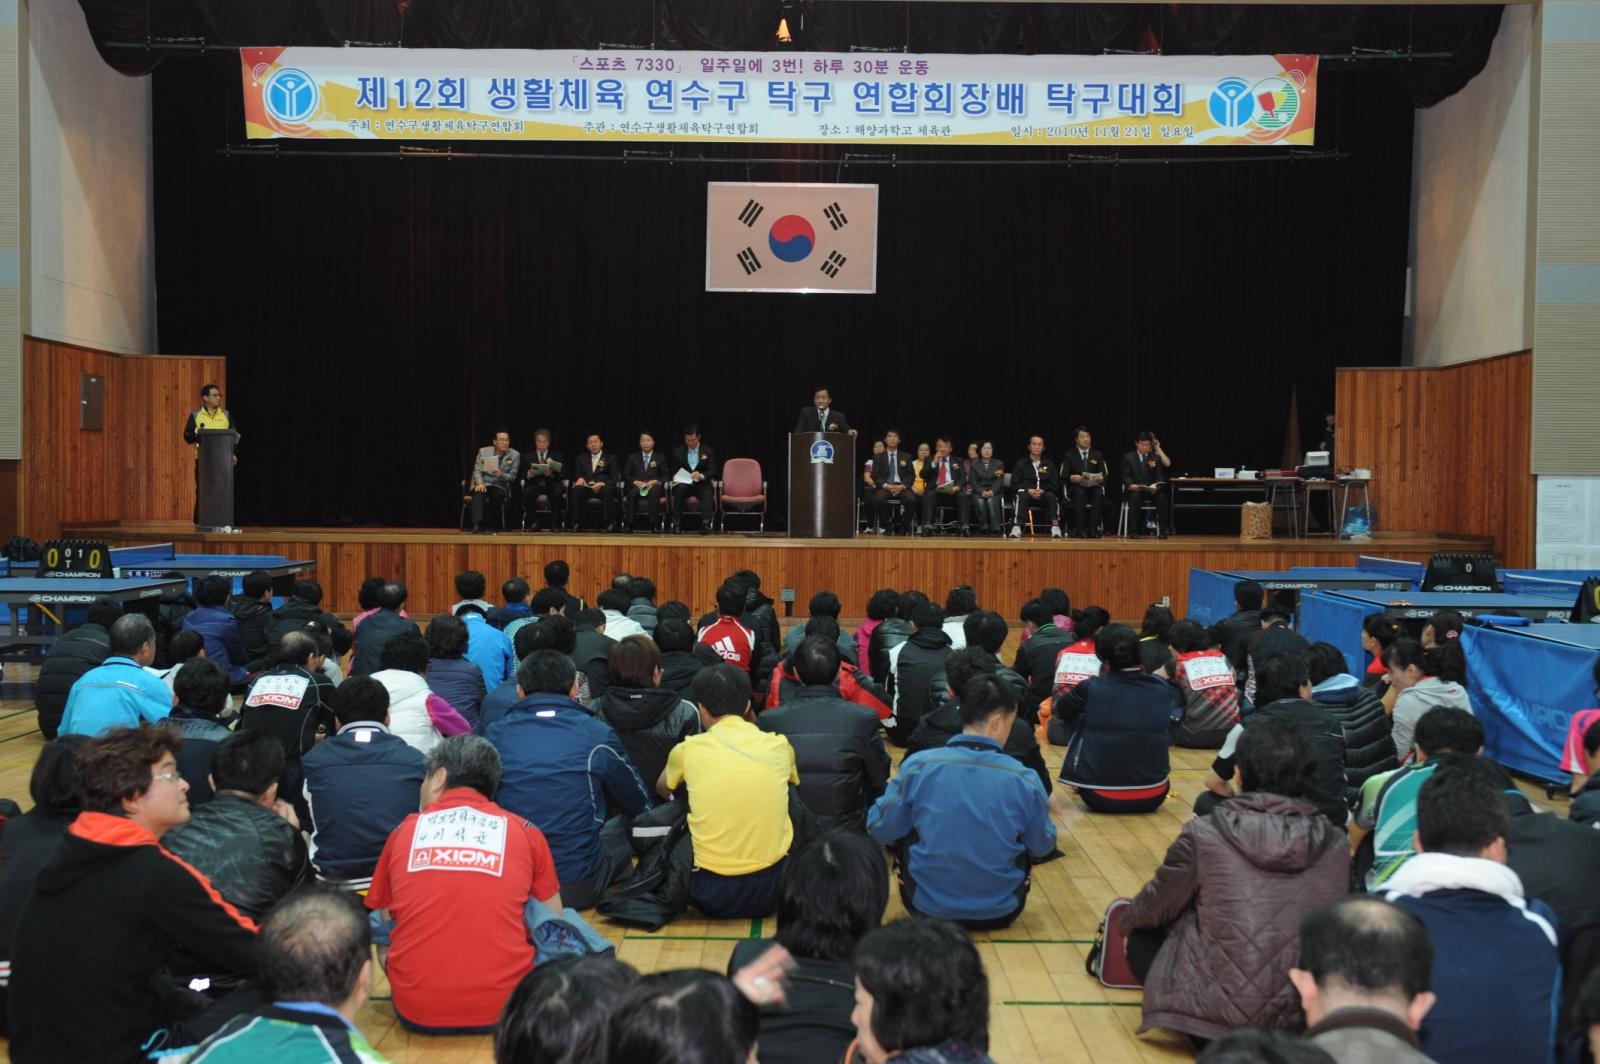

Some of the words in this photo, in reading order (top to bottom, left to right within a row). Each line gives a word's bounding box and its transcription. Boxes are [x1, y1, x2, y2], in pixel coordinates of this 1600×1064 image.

[700, 57, 763, 73] 일주일에
[772, 59, 803, 74] 3번!
[813, 59, 844, 74] 하루
[853, 60, 889, 75] 30분
[898, 60, 929, 75] 운동
[356, 76, 466, 110] 제12회
[487, 77, 625, 111] 생활체육
[645, 78, 746, 112] 연수구
[767, 80, 832, 113] 탁구
[853, 81, 1025, 116] 연합회장배
[1046, 82, 1182, 116] 탁구대회
[385, 119, 524, 132] 연수구생활체육탁구연합회
[583, 121, 606, 133] 주관
[620, 121, 759, 135] 연수구생활체육탁구연합회
[818, 123, 841, 136] 장소
[854, 124, 912, 136] 해양과학고
[918, 125, 952, 137] 체육관
[1011, 125, 1033, 137] 일시
[1047, 125, 1089, 138] 2010년
[1094, 125, 1121, 138] 11월
[1125, 126, 1151, 138] 21일
[1160, 126, 1194, 138] 일요일
[47, 548, 59, 568] 0
[89, 549, 100, 569] 0
[1444, 584, 1491, 592] CHAMPION
[1204, 675, 1231, 684] XIOM
[262, 694, 297, 705] XIOM
[434, 849, 496, 866] XIOM
